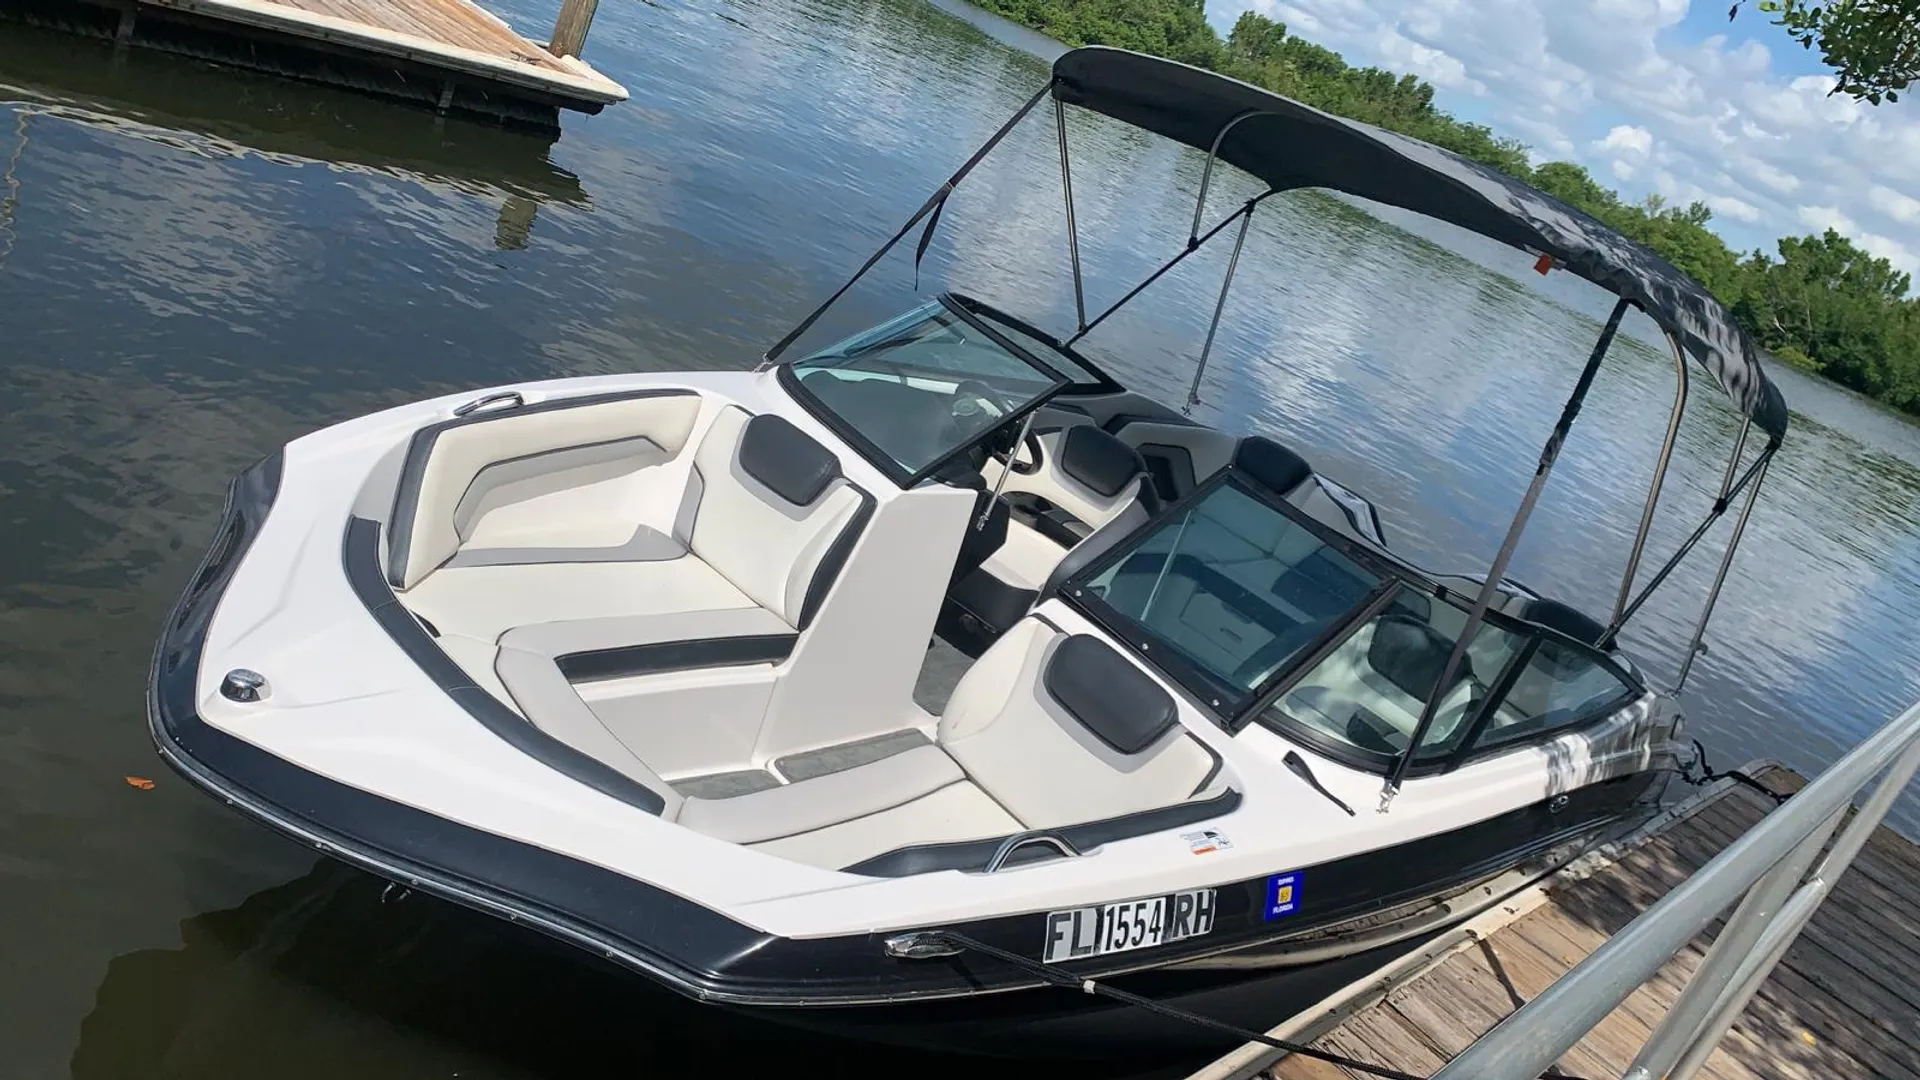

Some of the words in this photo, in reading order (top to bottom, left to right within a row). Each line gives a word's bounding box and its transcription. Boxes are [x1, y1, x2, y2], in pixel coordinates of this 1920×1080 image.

[1045, 911, 1093, 961] FL
[1105, 901, 1161, 951] 1554
[1172, 891, 1215, 938] RH
